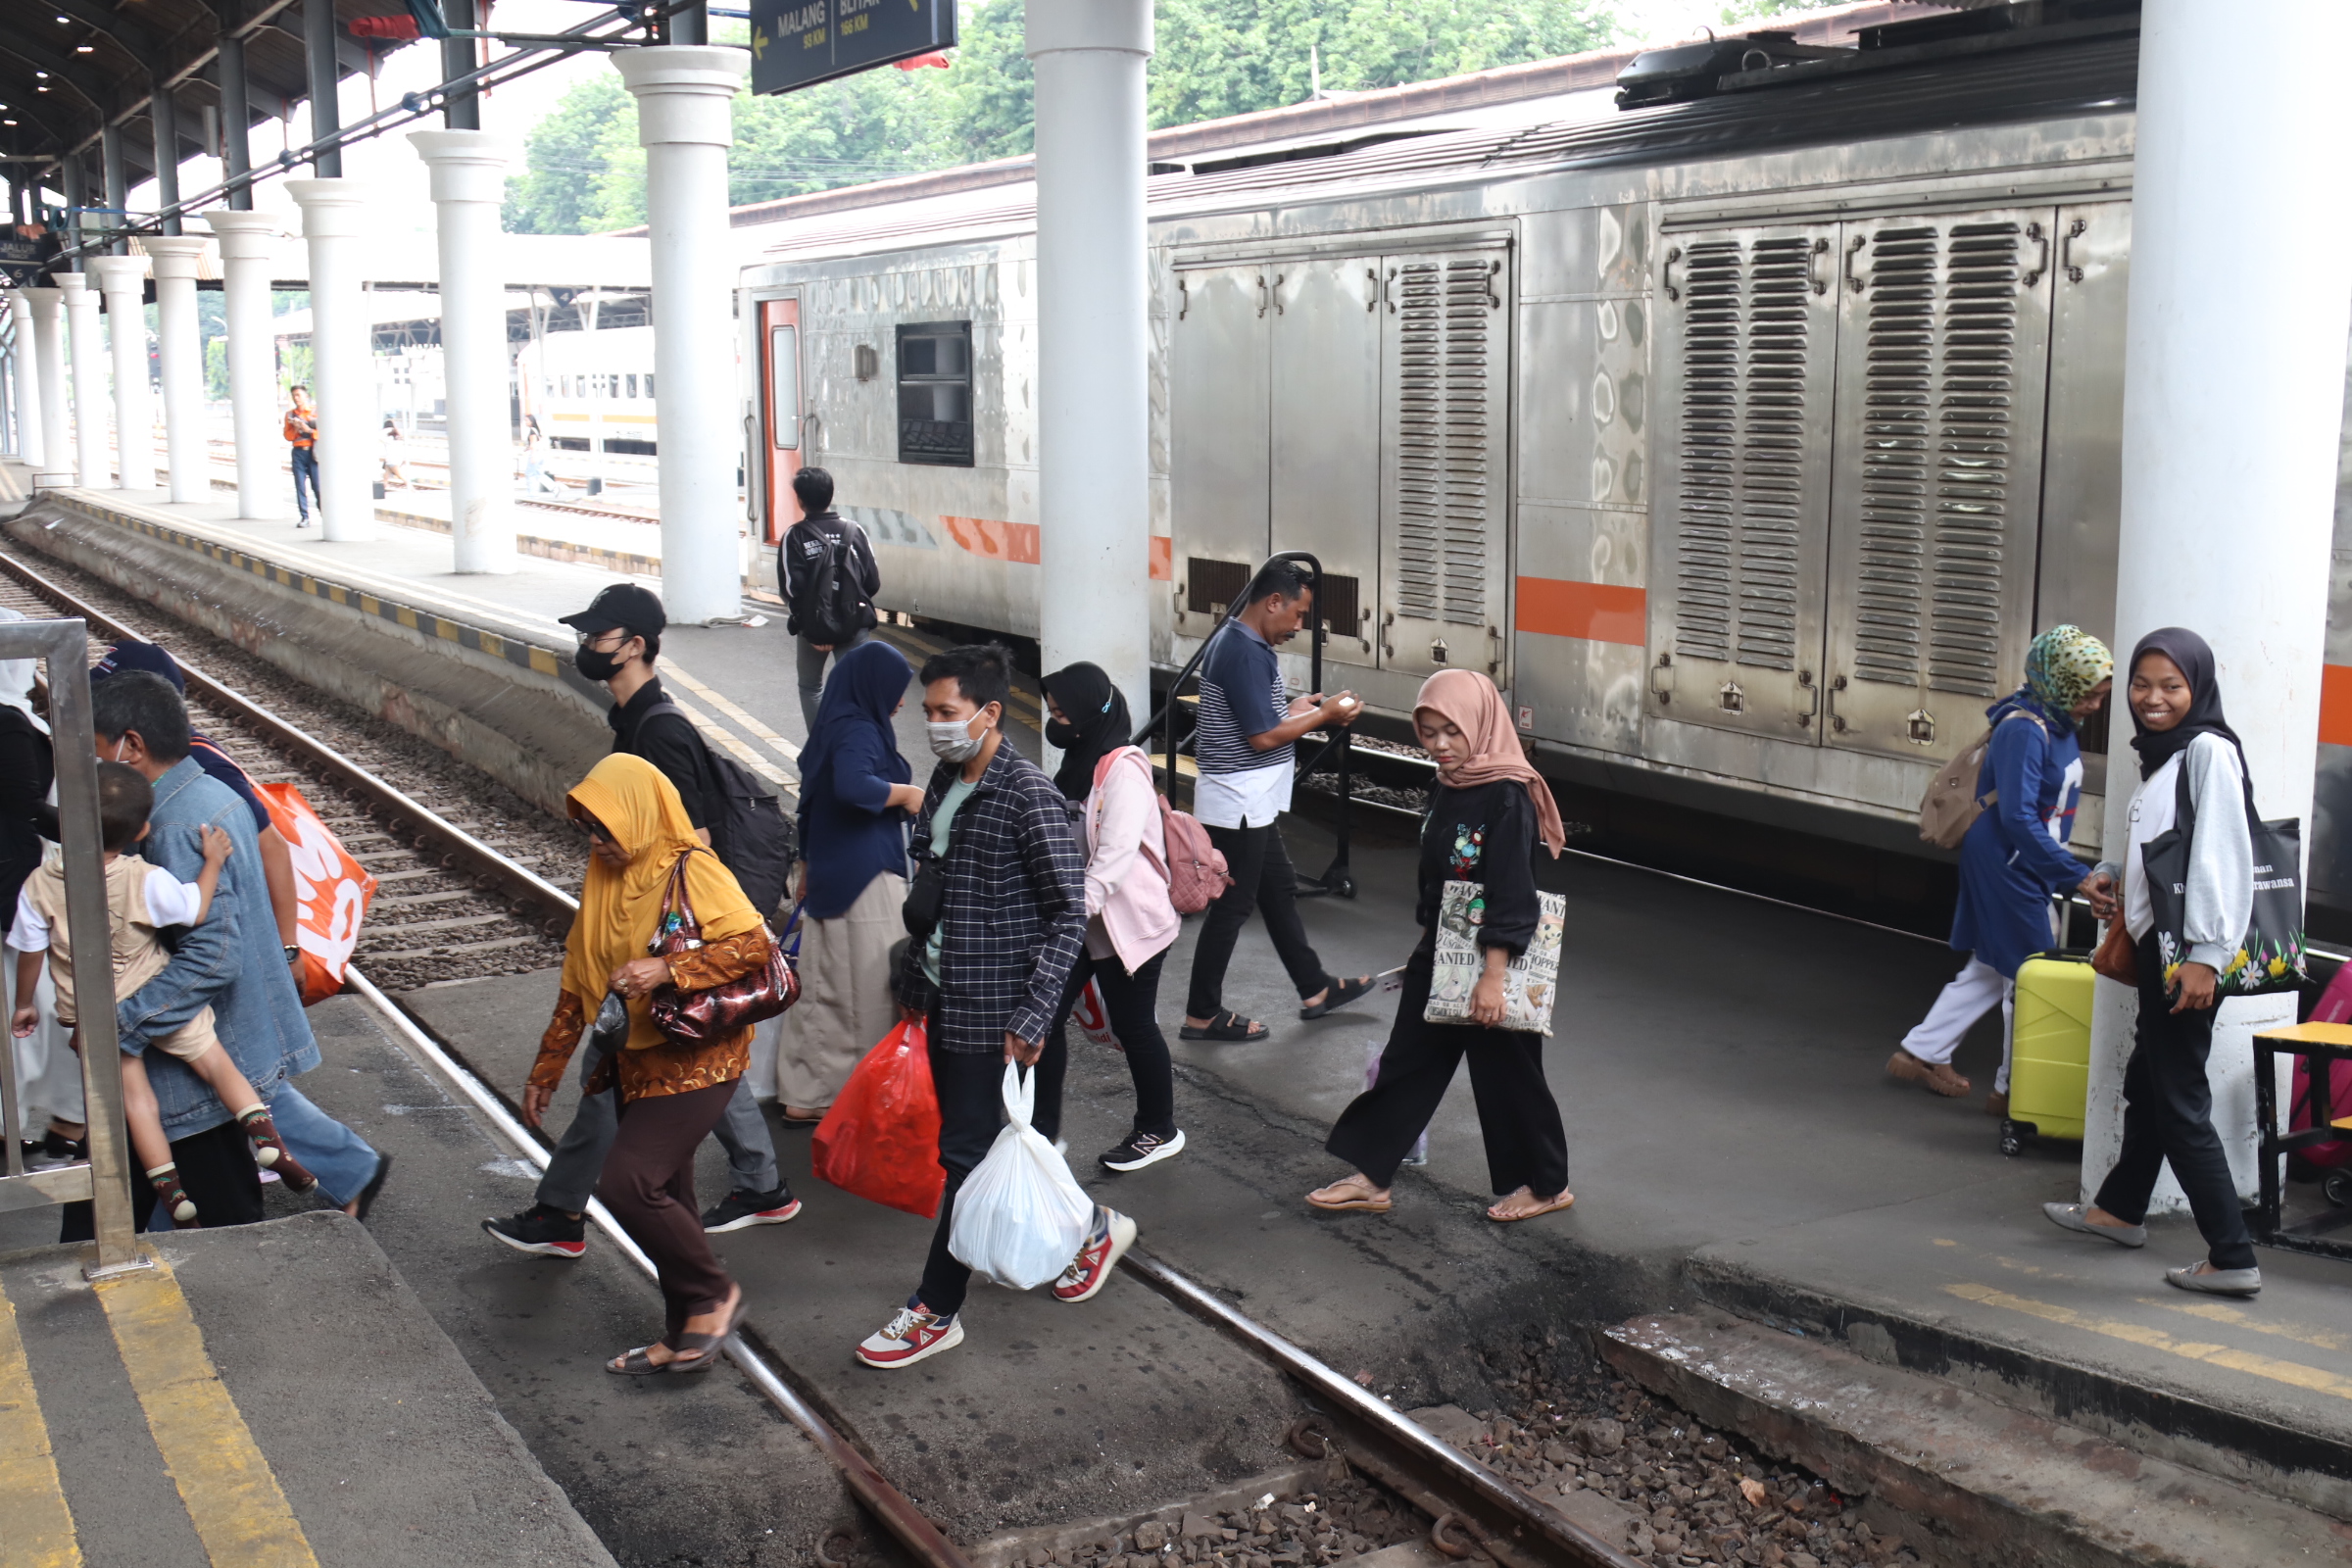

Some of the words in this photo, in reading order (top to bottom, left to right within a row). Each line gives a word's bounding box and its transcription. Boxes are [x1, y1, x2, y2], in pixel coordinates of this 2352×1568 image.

[778, 0, 825, 37] MALANG
[855, 13, 868, 31] KM
[804, 33, 813, 49] 93
[813, 27, 826, 46] KM
[0, 242, 36, 255] JALUR
[13, 269, 24, 278] 6
[560, 292, 570, 302] 4
[2253, 877, 2294, 891] rawansa
[1436, 952, 1475, 965] ANTED
